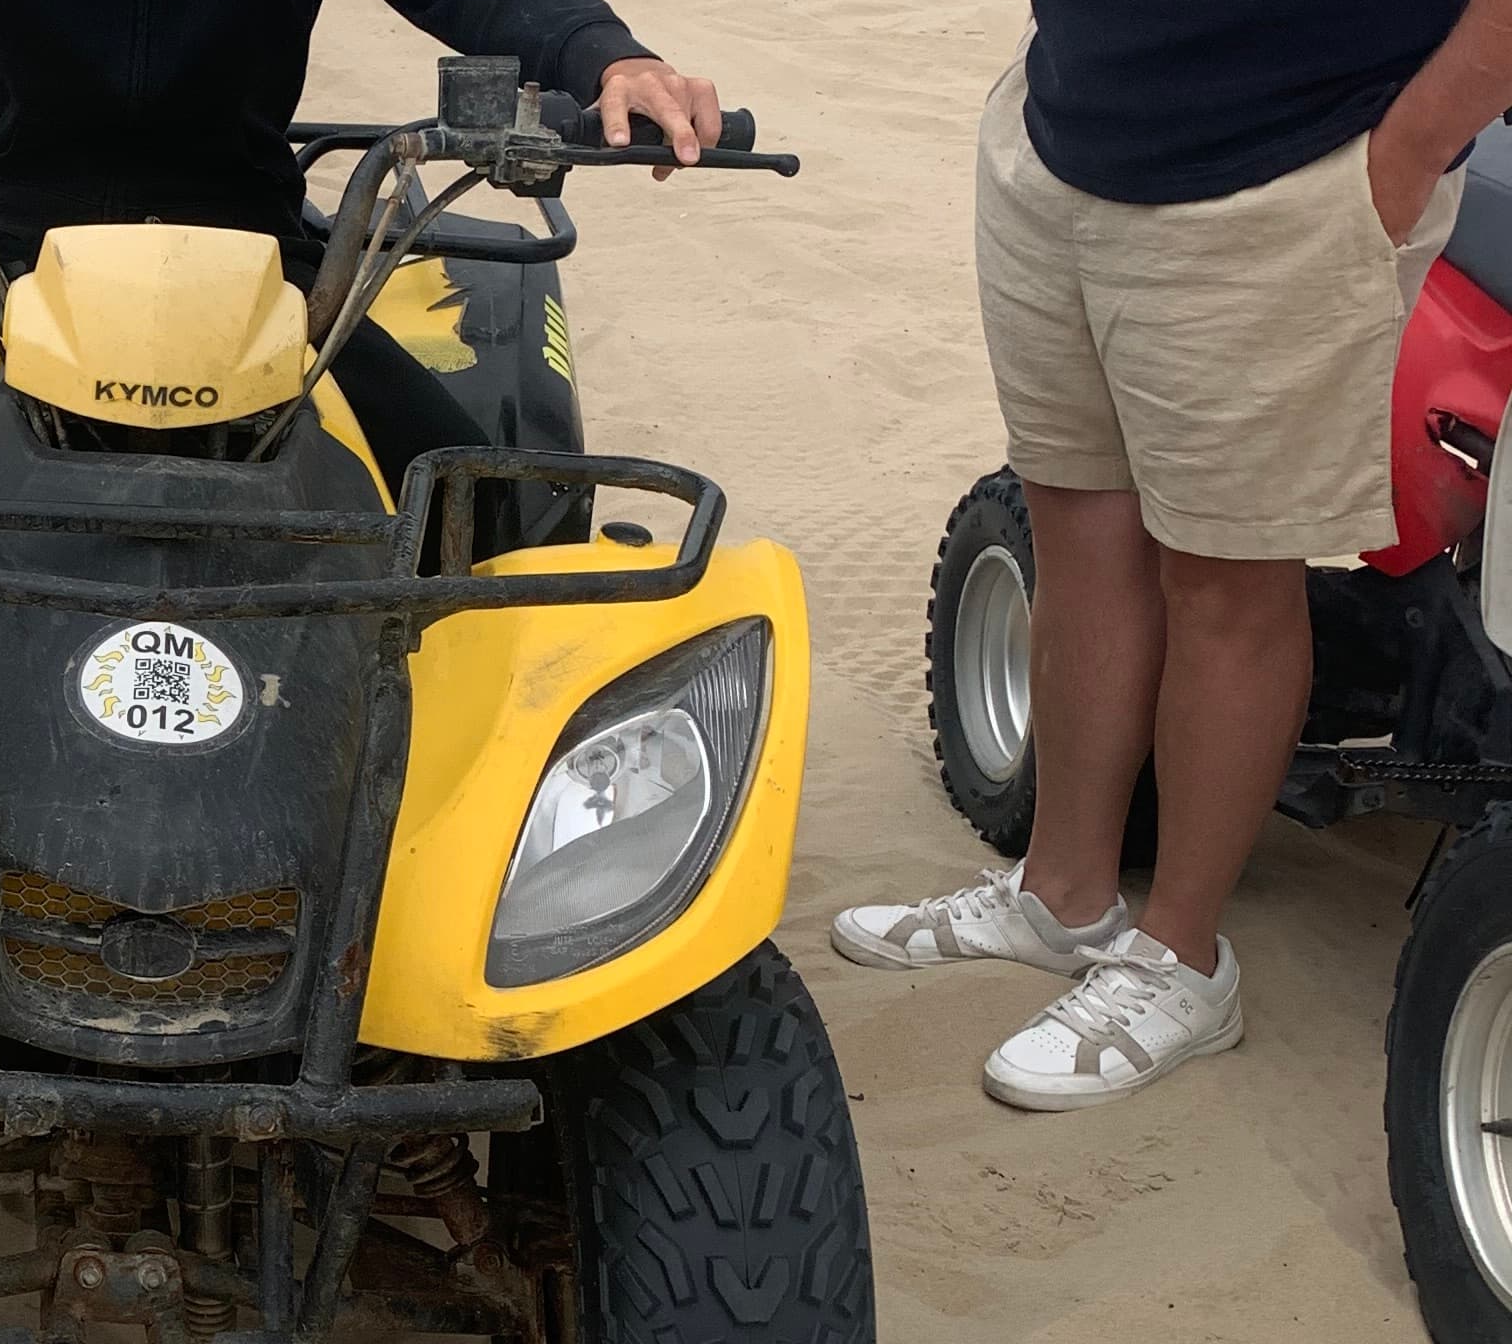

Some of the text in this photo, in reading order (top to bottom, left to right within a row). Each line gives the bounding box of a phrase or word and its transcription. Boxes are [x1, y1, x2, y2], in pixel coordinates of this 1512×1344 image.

[95, 380, 219, 408] KYMCO
[131, 630, 194, 659] QM
[126, 705, 195, 734] 012
